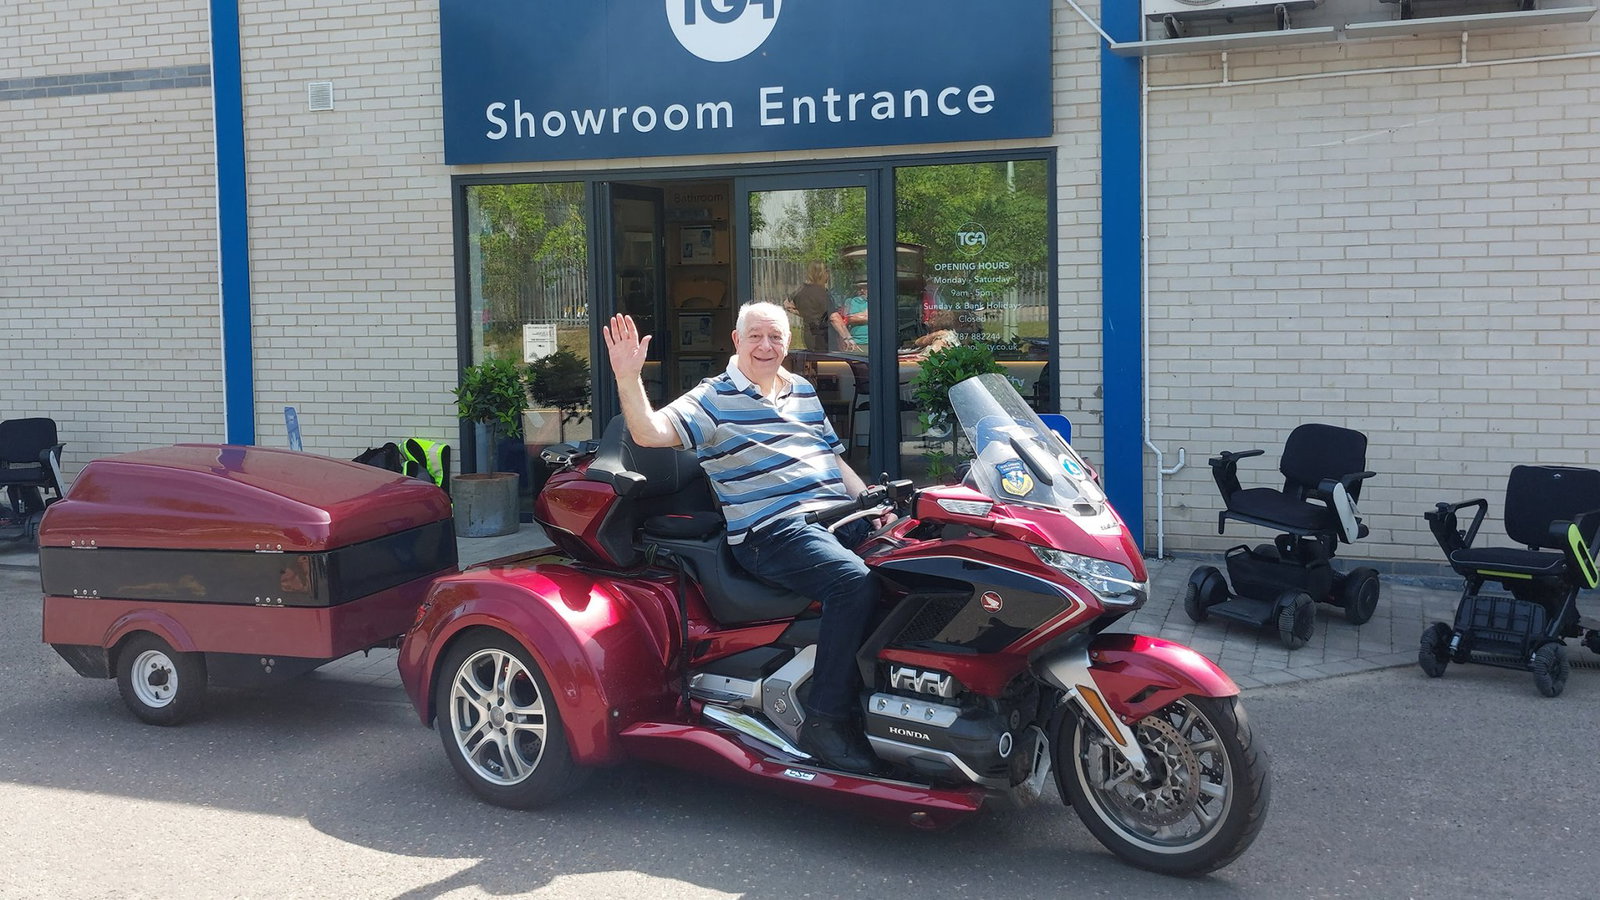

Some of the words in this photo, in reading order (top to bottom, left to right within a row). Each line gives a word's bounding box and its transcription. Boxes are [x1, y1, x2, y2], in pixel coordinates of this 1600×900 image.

[485, 99, 734, 140] Showroom
[759, 84, 996, 127] Entrance
[673, 193, 723, 203] Bathroom
[957, 231, 986, 246] TGA
[934, 262, 976, 271] OPENING
[978, 261, 1010, 270] HOURS
[933, 276, 967, 285] Monday
[974, 275, 1011, 285] Saturday
[950, 289, 968, 297] 9am
[975, 288, 993, 299] 5pm
[923, 302, 953, 312] Sunday
[955, 302, 961, 310] &
[964, 301, 985, 310] Bank
[958, 314, 987, 323] Closed
[971, 332, 1001, 341] 882244
[889, 727, 931, 741] HONDA
